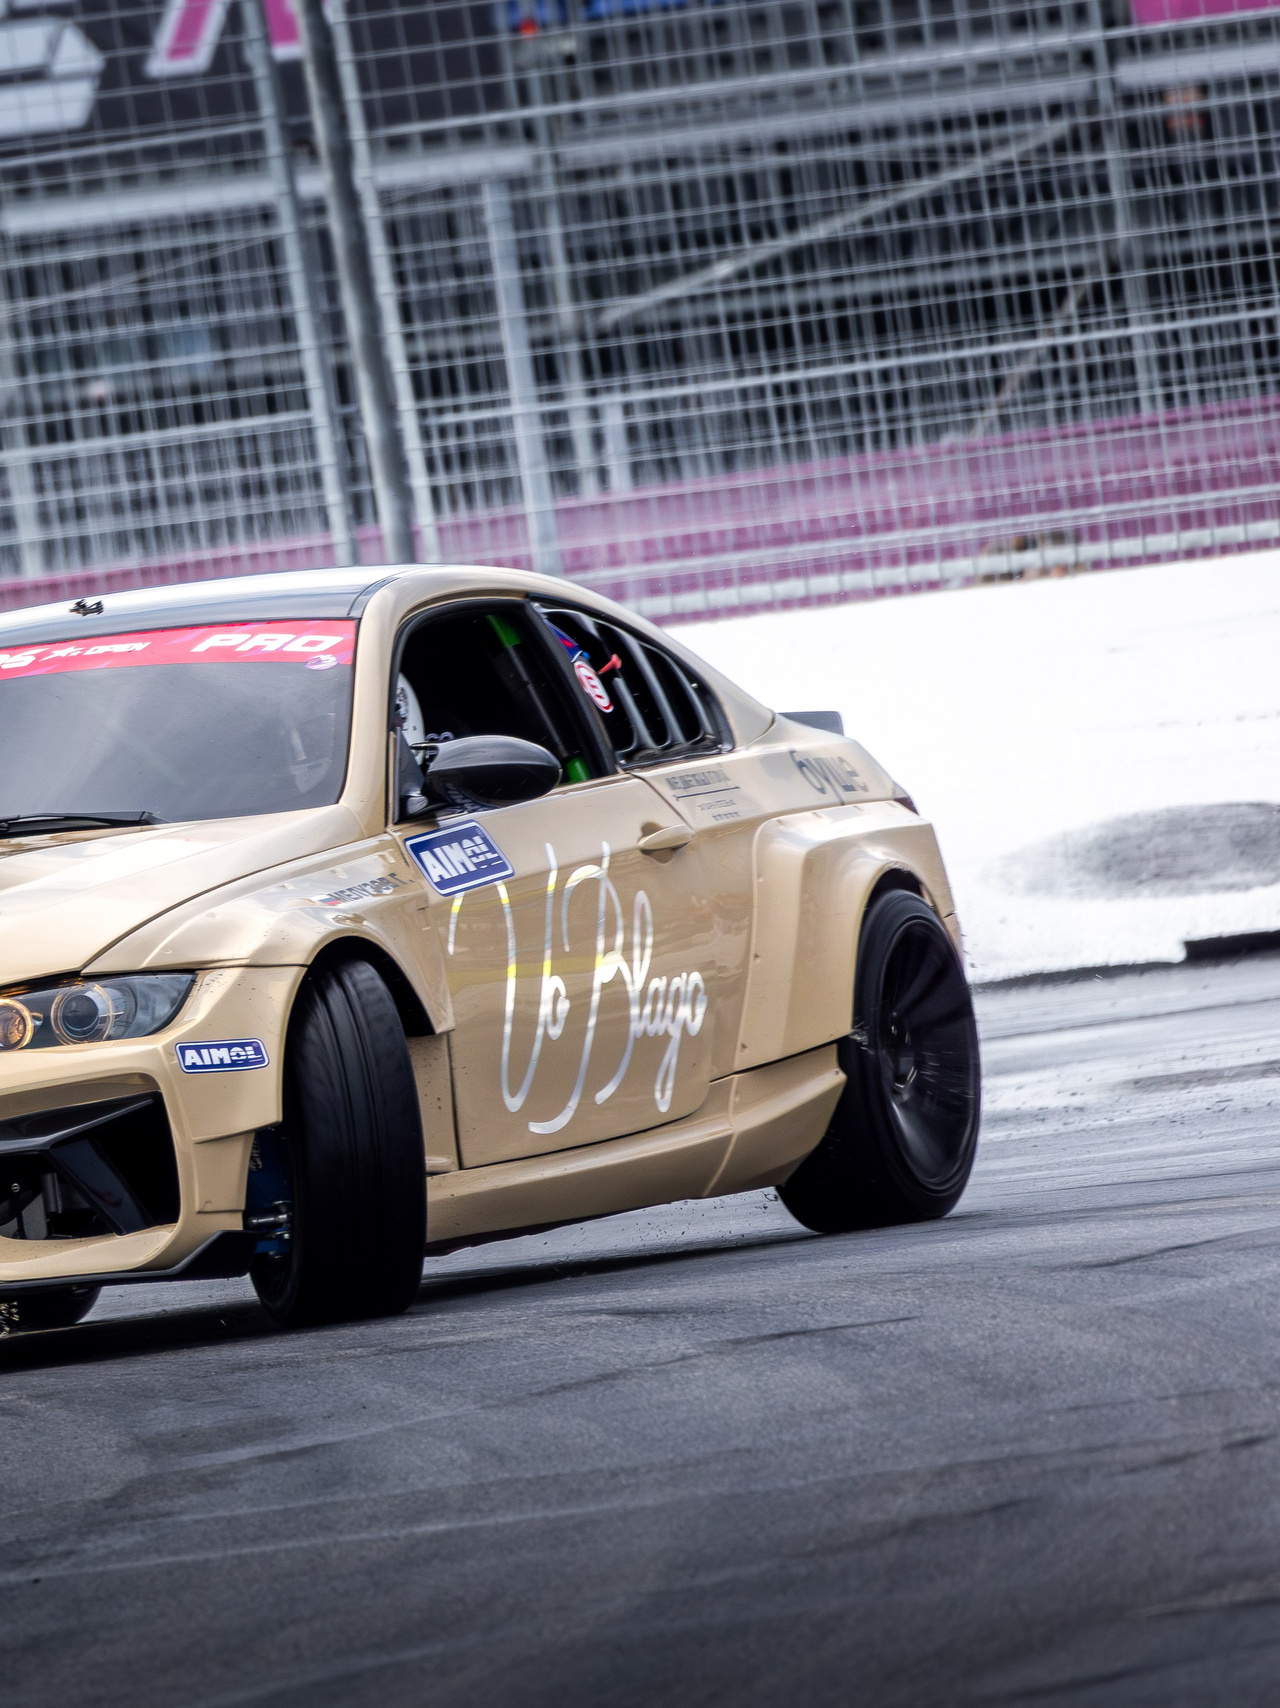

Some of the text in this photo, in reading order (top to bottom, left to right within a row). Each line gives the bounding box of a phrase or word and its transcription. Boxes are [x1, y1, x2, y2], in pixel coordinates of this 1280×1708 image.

[189, 633, 345, 653] PRO
[419, 835, 502, 883] AIMOL
[184, 1046, 263, 1066] AIMOL
